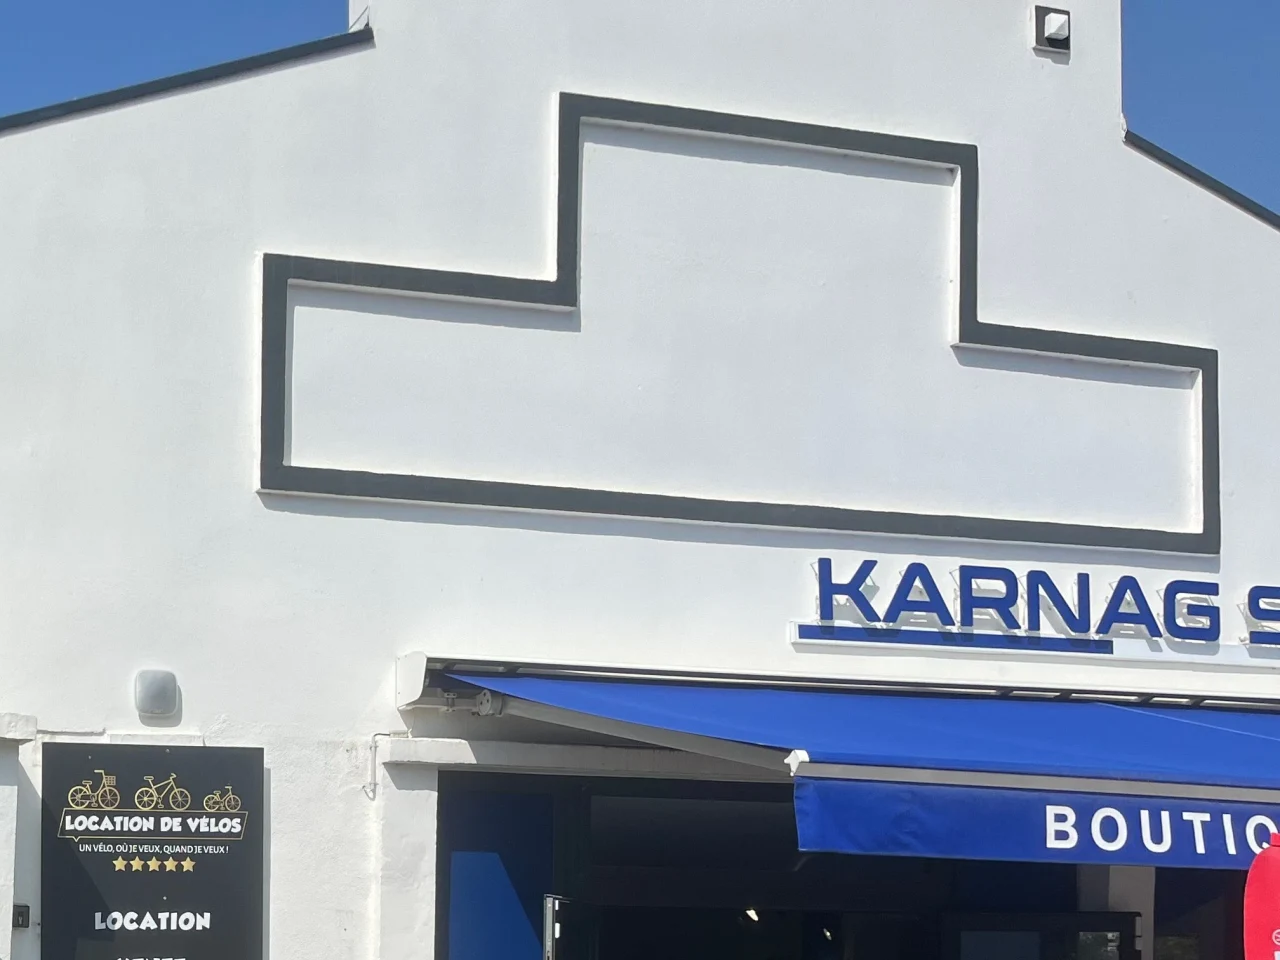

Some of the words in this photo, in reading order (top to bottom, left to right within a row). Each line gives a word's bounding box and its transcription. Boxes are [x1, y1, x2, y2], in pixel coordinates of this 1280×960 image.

[817, 557, 1220, 643] KARNAG
[65, 815, 155, 832] LOCATION
[160, 816, 182, 832] DE
[186, 815, 242, 833] VÉLOS
[1045, 804, 1279, 855] BOUTIQ
[79, 844, 91, 853] UN
[93, 842, 115, 854] VÉLO,
[116, 842, 128, 853] OÙ
[128, 845, 138, 854] JE
[138, 845, 163, 854] VEUX,
[163, 845, 194, 855] QUAND
[193, 846, 204, 855] JE
[204, 846, 225, 854] VEUX
[95, 911, 210, 930] LOCATION
